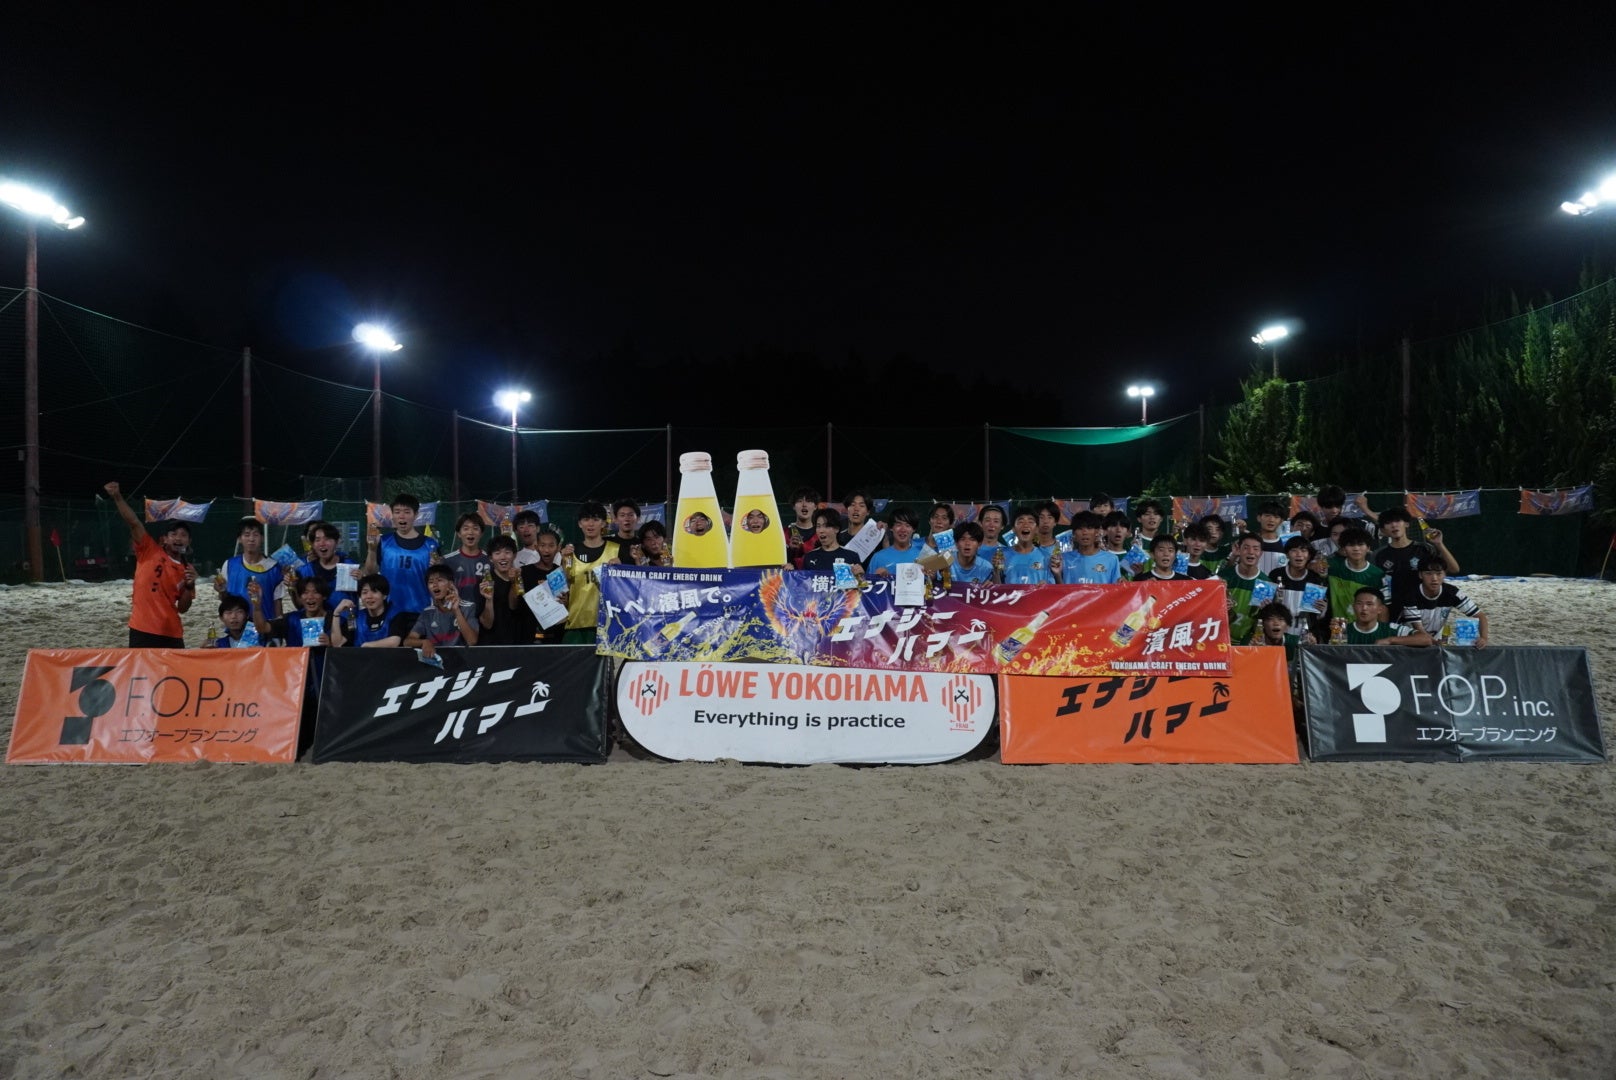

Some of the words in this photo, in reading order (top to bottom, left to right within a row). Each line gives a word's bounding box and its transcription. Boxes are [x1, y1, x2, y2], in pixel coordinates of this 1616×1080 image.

[399, 555, 412, 569] 15
[608, 569, 646, 579] YOKOHAMA
[649, 571, 671, 580] CRAFT
[673, 572, 698, 581] ENERGY
[700, 573, 723, 582] DRINK
[831, 606, 959, 642] エナジー
[1141, 617, 1221, 656] 濱風力
[1110, 661, 1149, 670] YOKOHAMA
[1151, 662, 1173, 670] CRAFT
[1175, 662, 1201, 670] ENERGY
[1203, 662, 1227, 670] DRINK
[125, 676, 224, 718] F.O.P.
[225, 697, 261, 718] inc.
[373, 666, 522, 718] エナジー
[767, 671, 929, 702] YOKOHAMA
[1410, 674, 1507, 716] F.O.P.
[1512, 695, 1555, 716] inc.
[694, 709, 799, 730] Everything
[805, 712, 821, 727] is
[827, 712, 906, 731] practice
